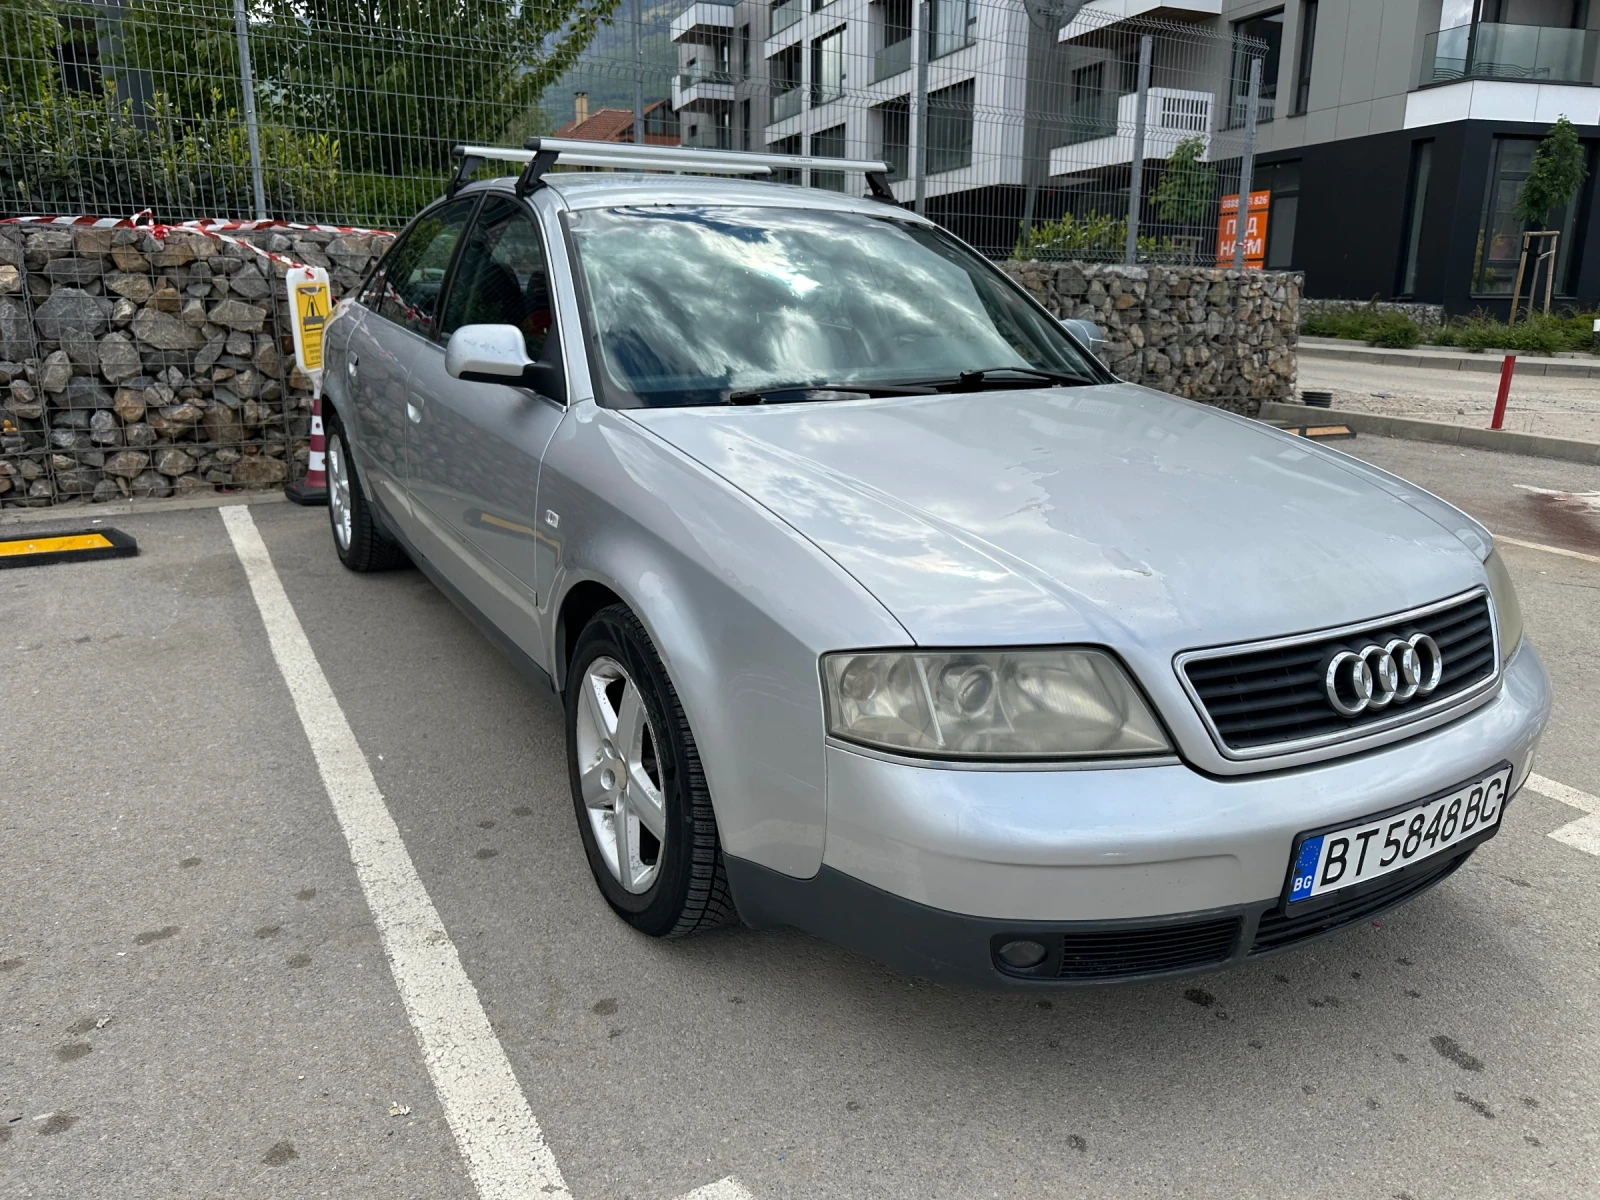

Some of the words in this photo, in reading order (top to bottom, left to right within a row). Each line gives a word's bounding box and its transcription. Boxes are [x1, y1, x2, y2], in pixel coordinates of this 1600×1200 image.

[1226, 217, 1257, 236] ПД
[1319, 825, 1381, 887] BT
[1379, 798, 1462, 868] 5848
[1460, 777, 1502, 834] BC
[1293, 874, 1313, 893] BG
